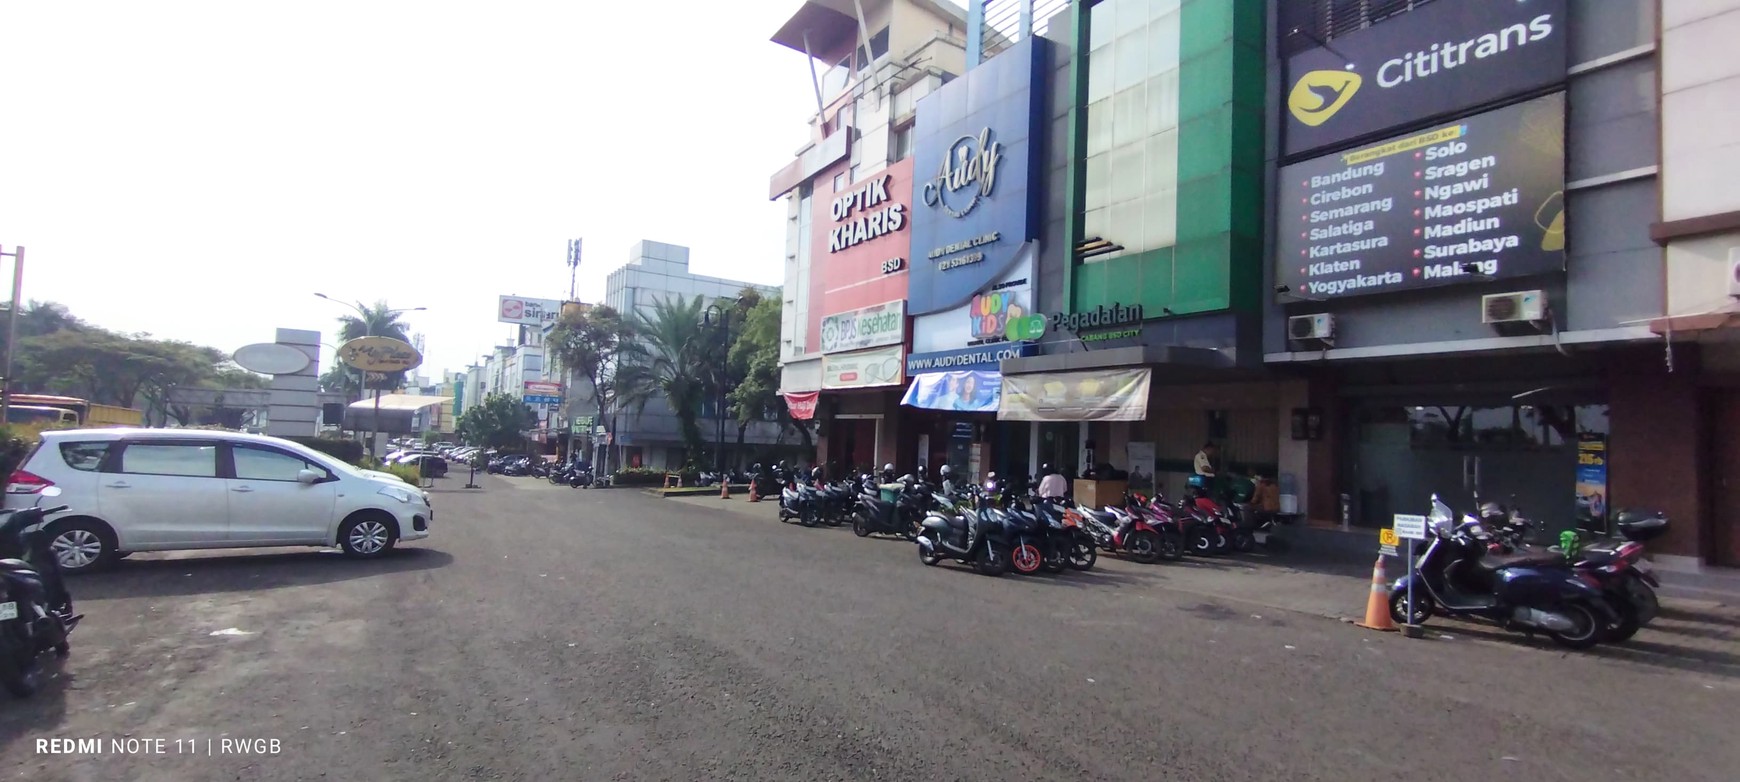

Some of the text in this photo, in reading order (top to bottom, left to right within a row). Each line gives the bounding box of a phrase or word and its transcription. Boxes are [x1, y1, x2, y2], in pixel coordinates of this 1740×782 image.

[1377, 14, 1552, 88] Cititrans
[1349, 144, 1396, 162] Berangkat
[1418, 133, 1439, 144] BSD
[1425, 141, 1467, 160] Solo
[923, 127, 999, 207] Audy
[1311, 162, 1384, 188] Bandung
[1424, 155, 1495, 180] Sragen
[831, 174, 889, 221] OPTIK
[1310, 183, 1373, 205] Cirebon
[1424, 173, 1488, 200] Ngawi
[1310, 197, 1392, 223] Semarang
[1424, 188, 1518, 220] Maospati
[829, 203, 904, 252] KHARIS
[1309, 220, 1374, 240] Salatiga
[1424, 217, 1500, 239] Madiun
[946, 240, 973, 254] DENTAL
[973, 231, 999, 246] CLINIC
[1309, 236, 1389, 258] Kartasura
[1423, 235, 1519, 259] Surabaya
[881, 257, 903, 274] BSD
[1309, 259, 1360, 276] Klaten
[1308, 271, 1402, 294] Yogyakarta
[970, 290, 1010, 318] AUDY
[841, 319, 857, 340] BPJS
[1050, 302, 1142, 334] Pegadaian
[1122, 329, 1141, 337] CITY
[908, 349, 1020, 370] WWW.AUDYDENTAL.COM
